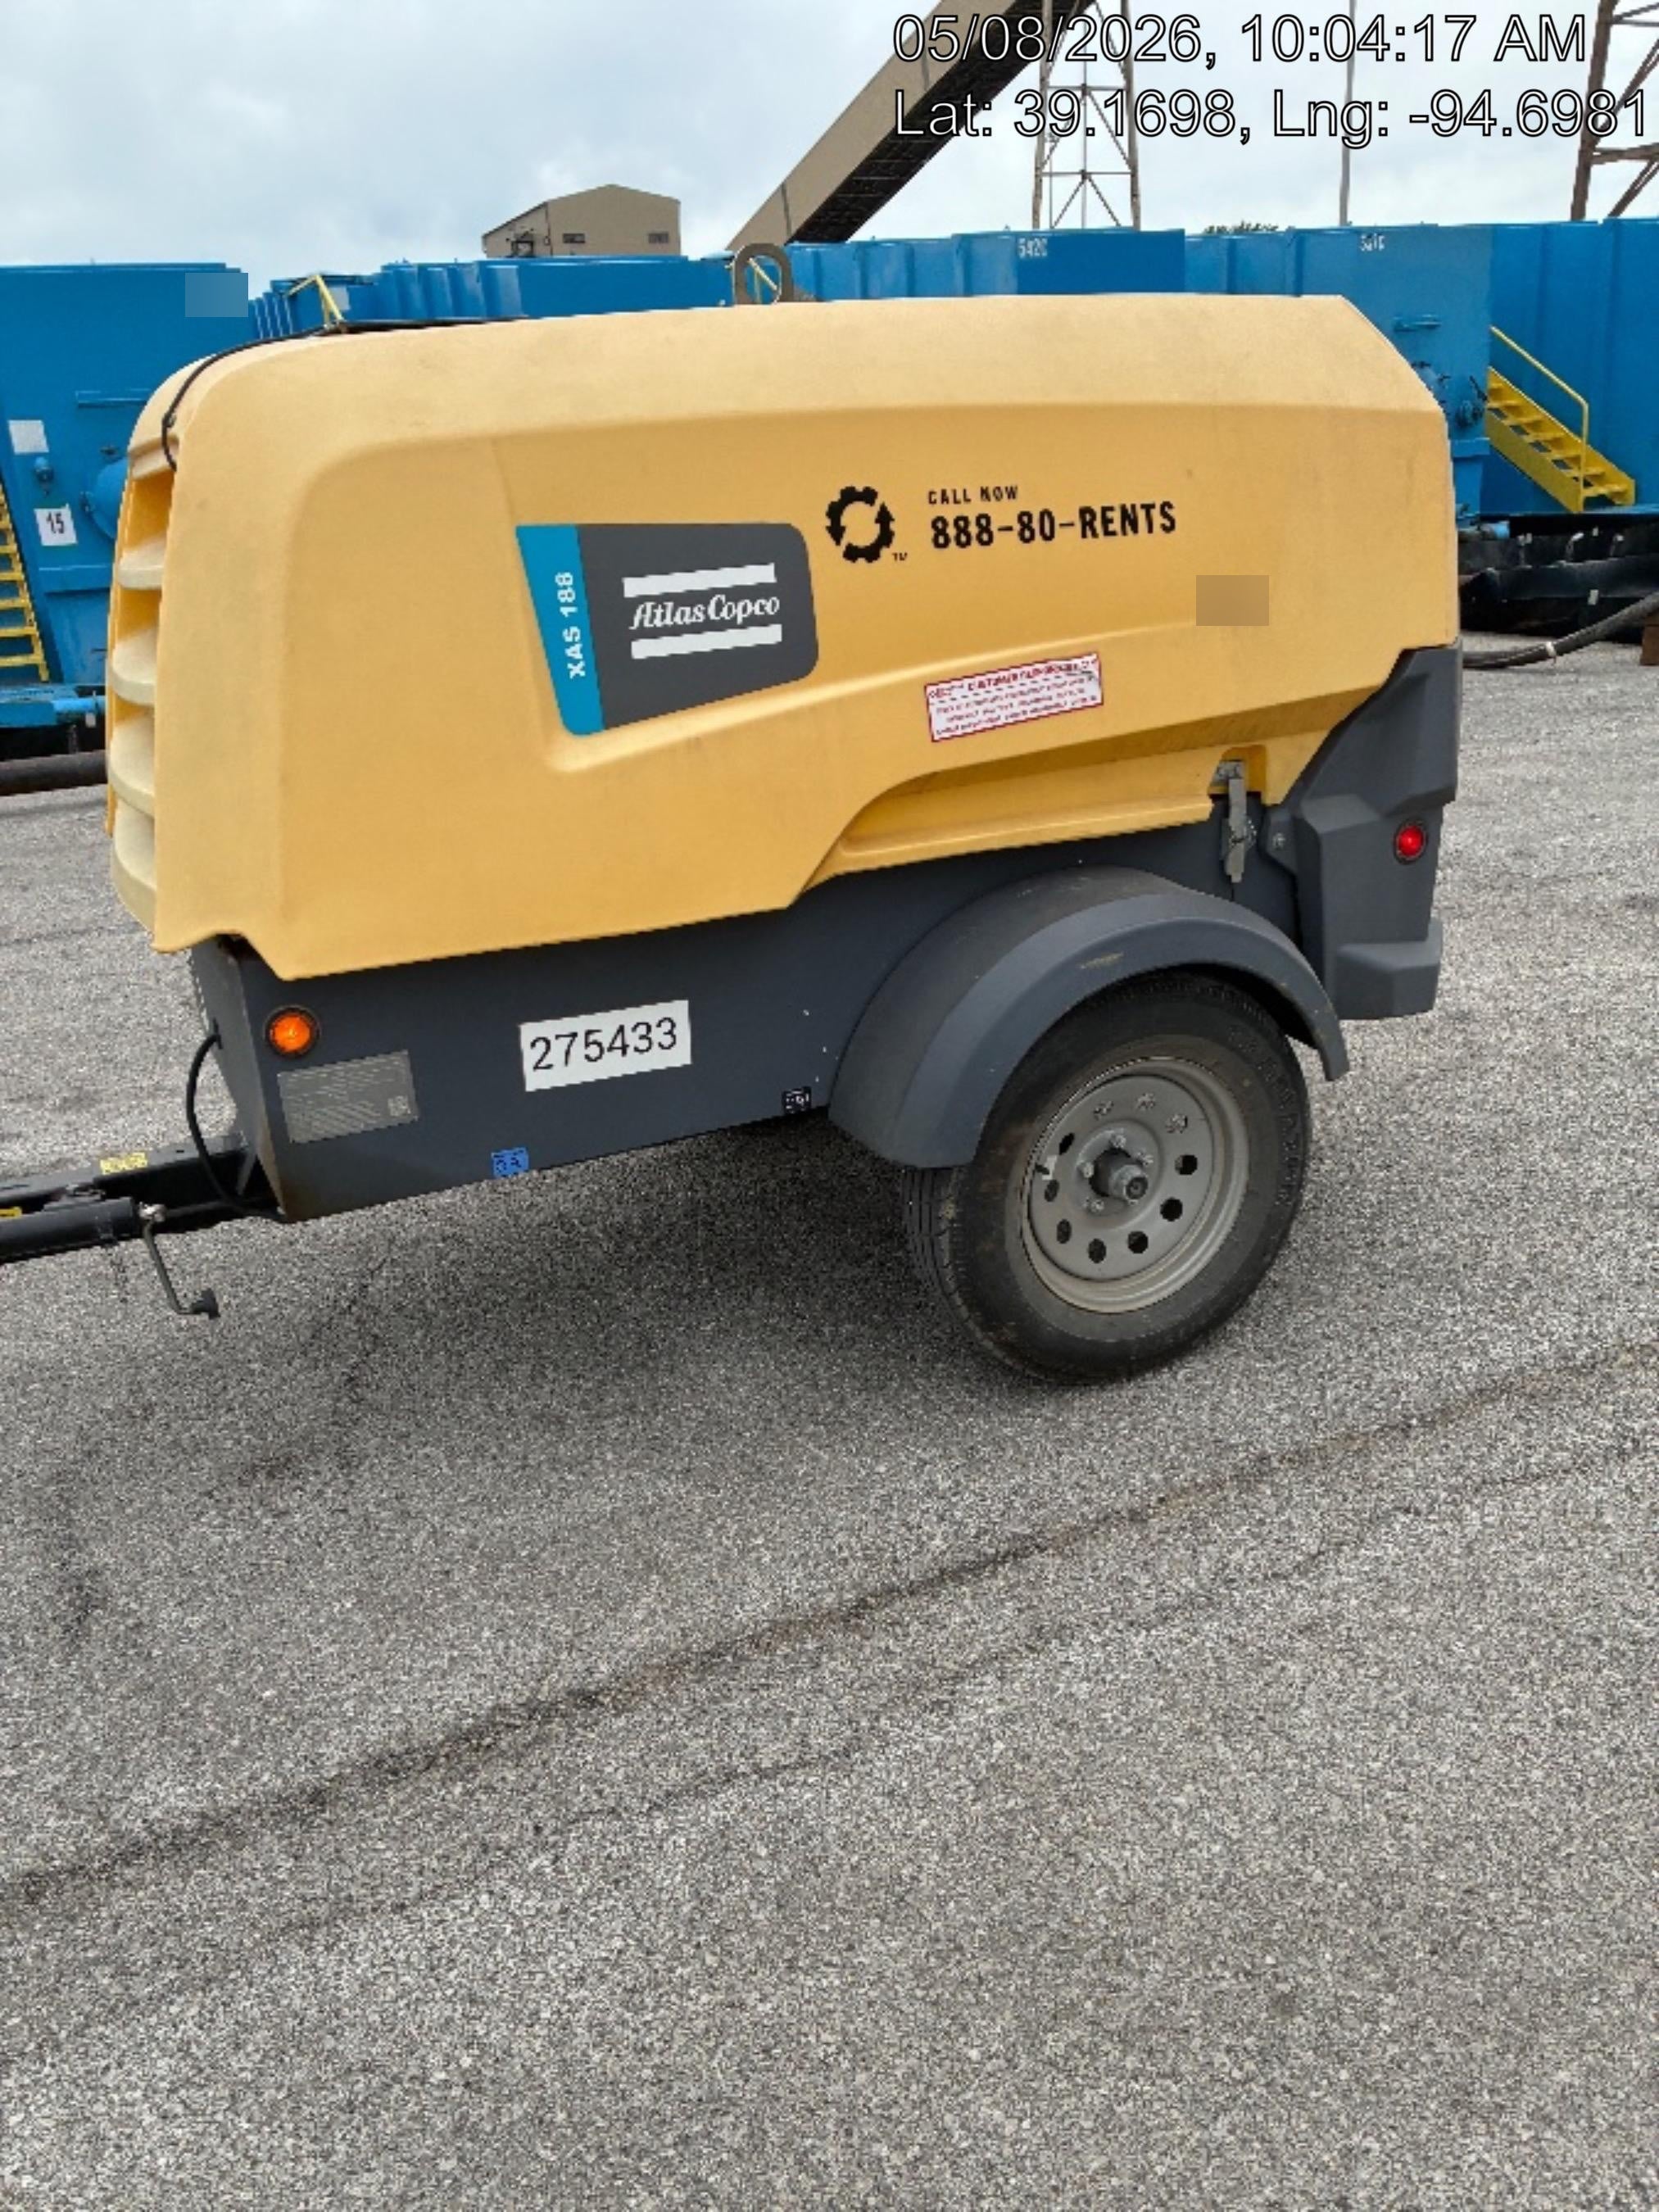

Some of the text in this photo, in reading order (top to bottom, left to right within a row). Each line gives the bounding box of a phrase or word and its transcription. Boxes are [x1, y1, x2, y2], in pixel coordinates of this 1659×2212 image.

[928, 486, 1018, 505] CALL NOW
[46, 512, 65, 533] 15
[931, 501, 1176, 549] 888-80-RENTS
[555, 572, 586, 678] XAS 188
[629, 595, 780, 629] Atlas Copco
[530, 1017, 677, 1072] 275433
